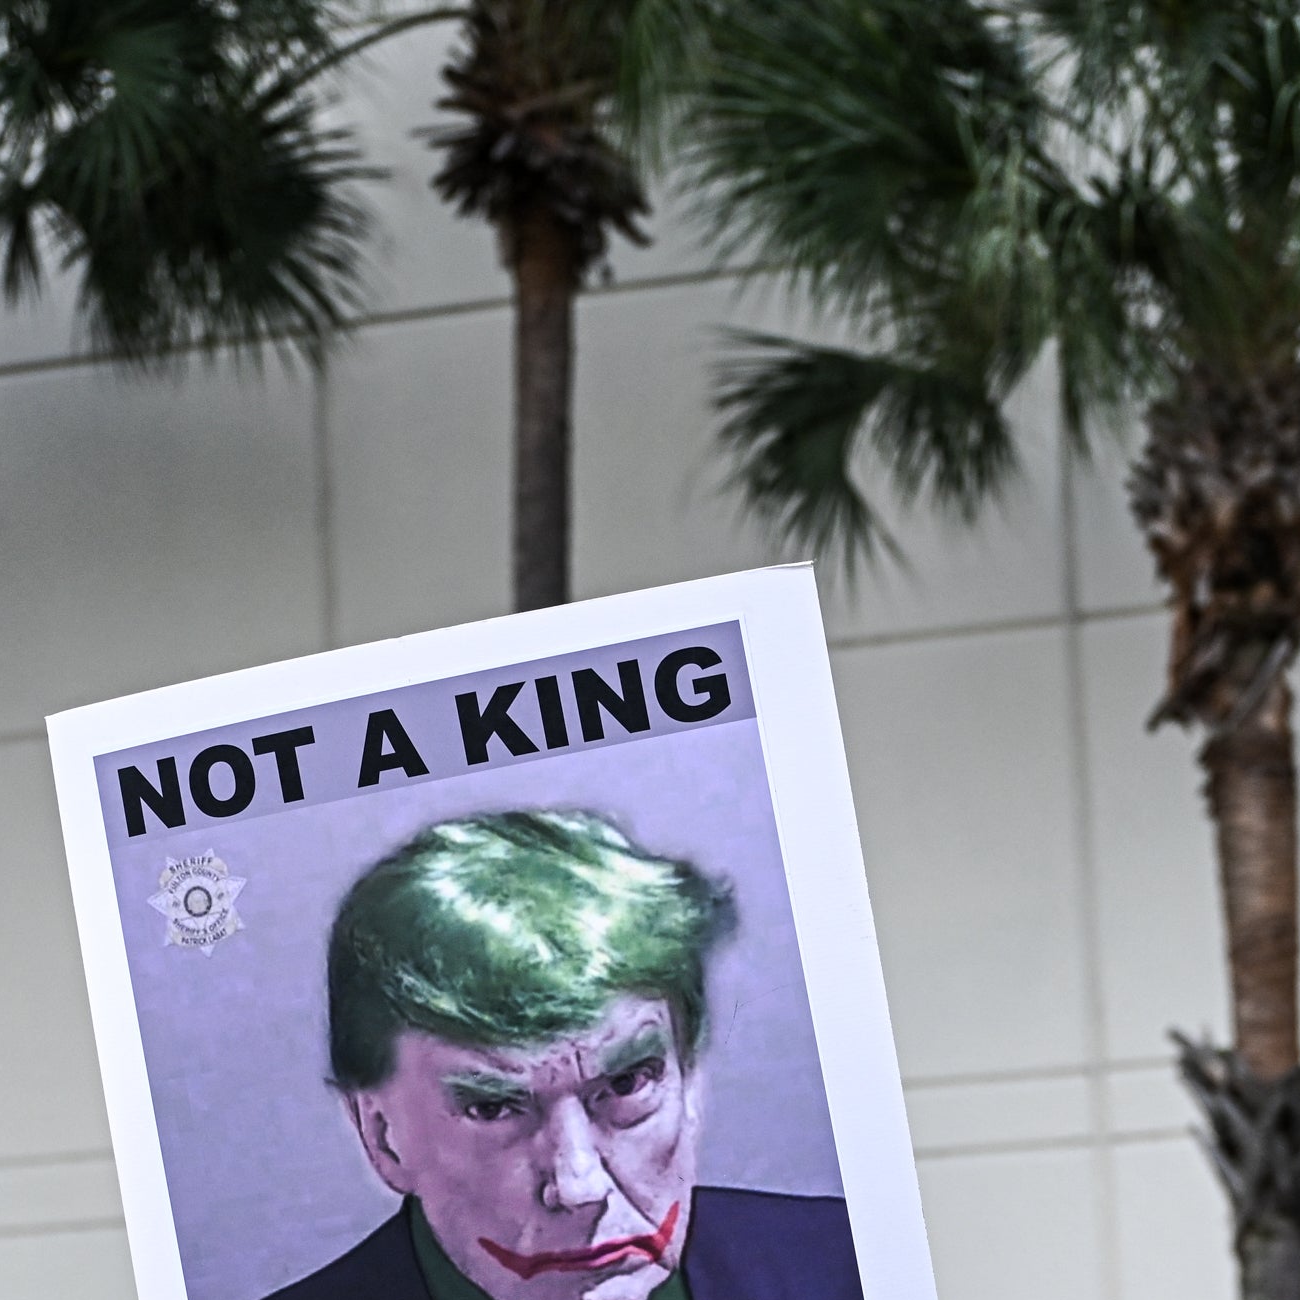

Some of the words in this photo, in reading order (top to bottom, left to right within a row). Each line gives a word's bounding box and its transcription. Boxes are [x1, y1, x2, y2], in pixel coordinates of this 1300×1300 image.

[117, 724, 316, 839] NOT
[357, 708, 431, 789] A
[455, 645, 733, 765] KING
[169, 856, 213, 874] SHERIFF
[191, 868, 220, 882] COUNTY
